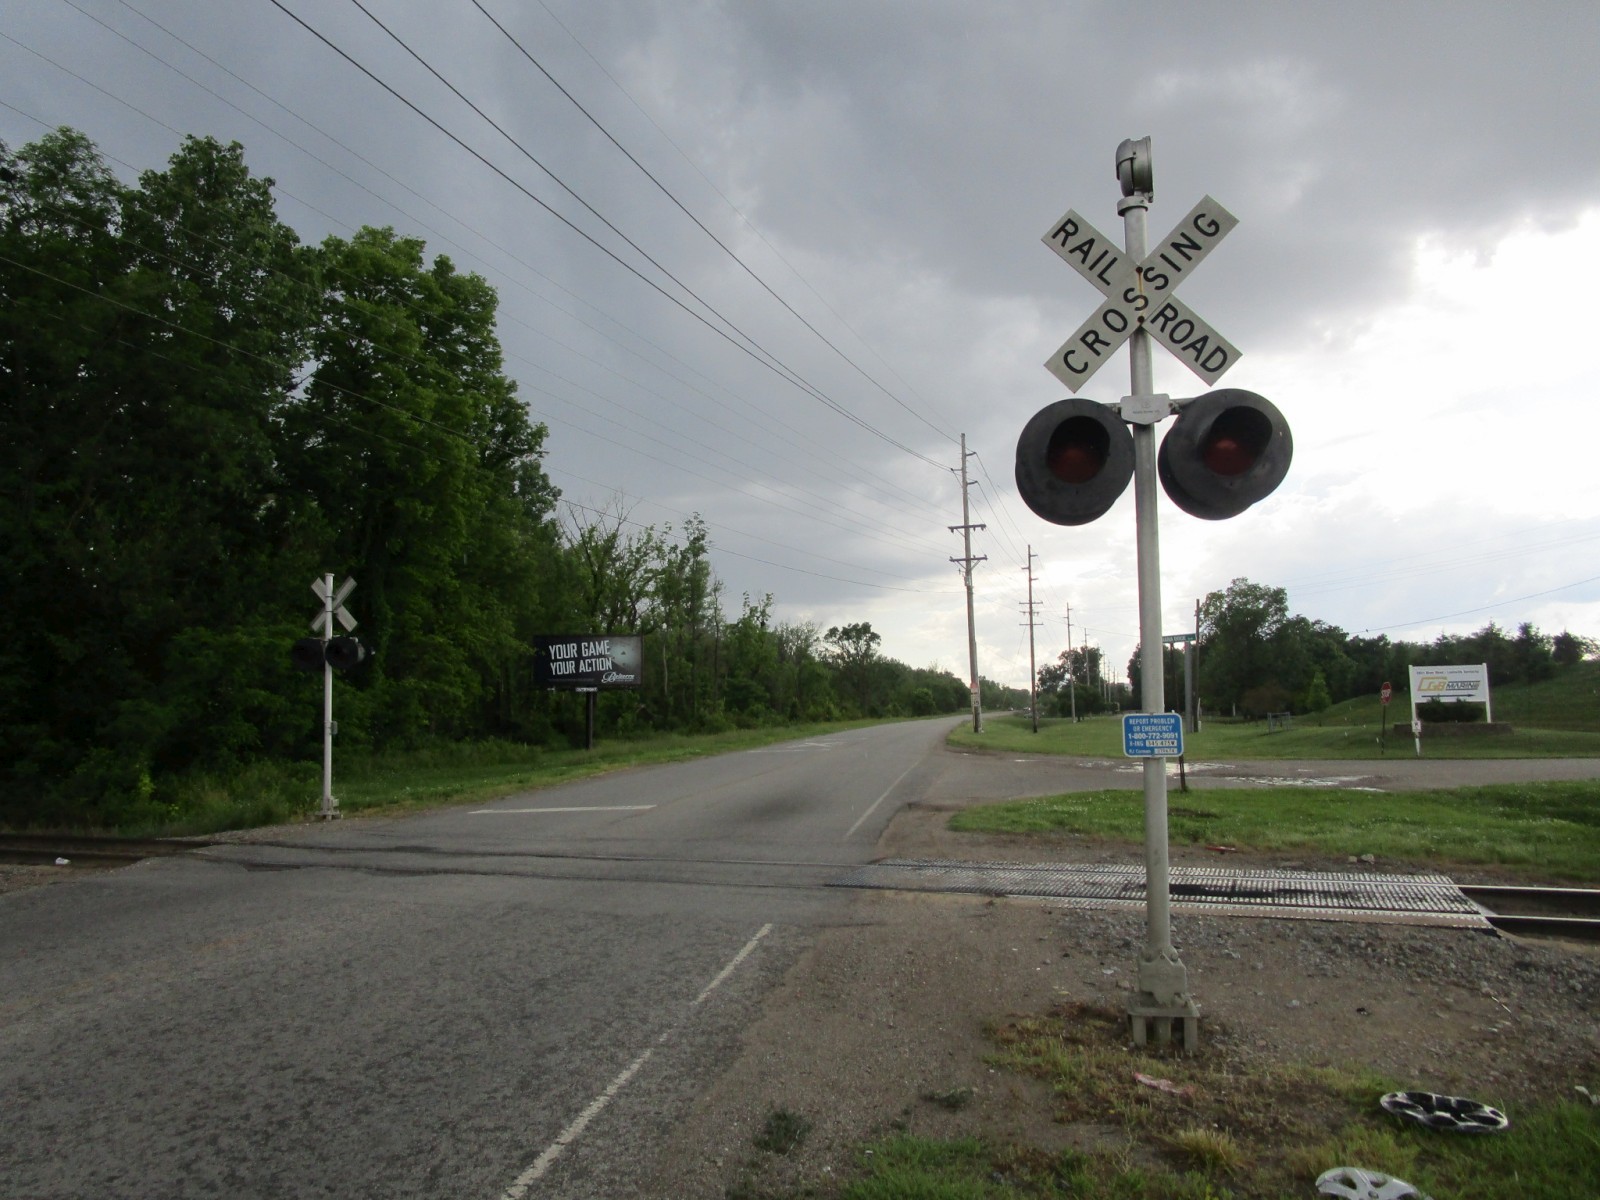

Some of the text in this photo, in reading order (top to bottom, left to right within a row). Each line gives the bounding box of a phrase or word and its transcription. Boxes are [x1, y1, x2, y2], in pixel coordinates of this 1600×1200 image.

[1051, 217, 1228, 373] RAIL ROAD
[1062, 212, 1221, 375] CROSSING
[549, 640, 611, 660] YOUR GAME
[550, 657, 613, 675] YOUR ACTION
